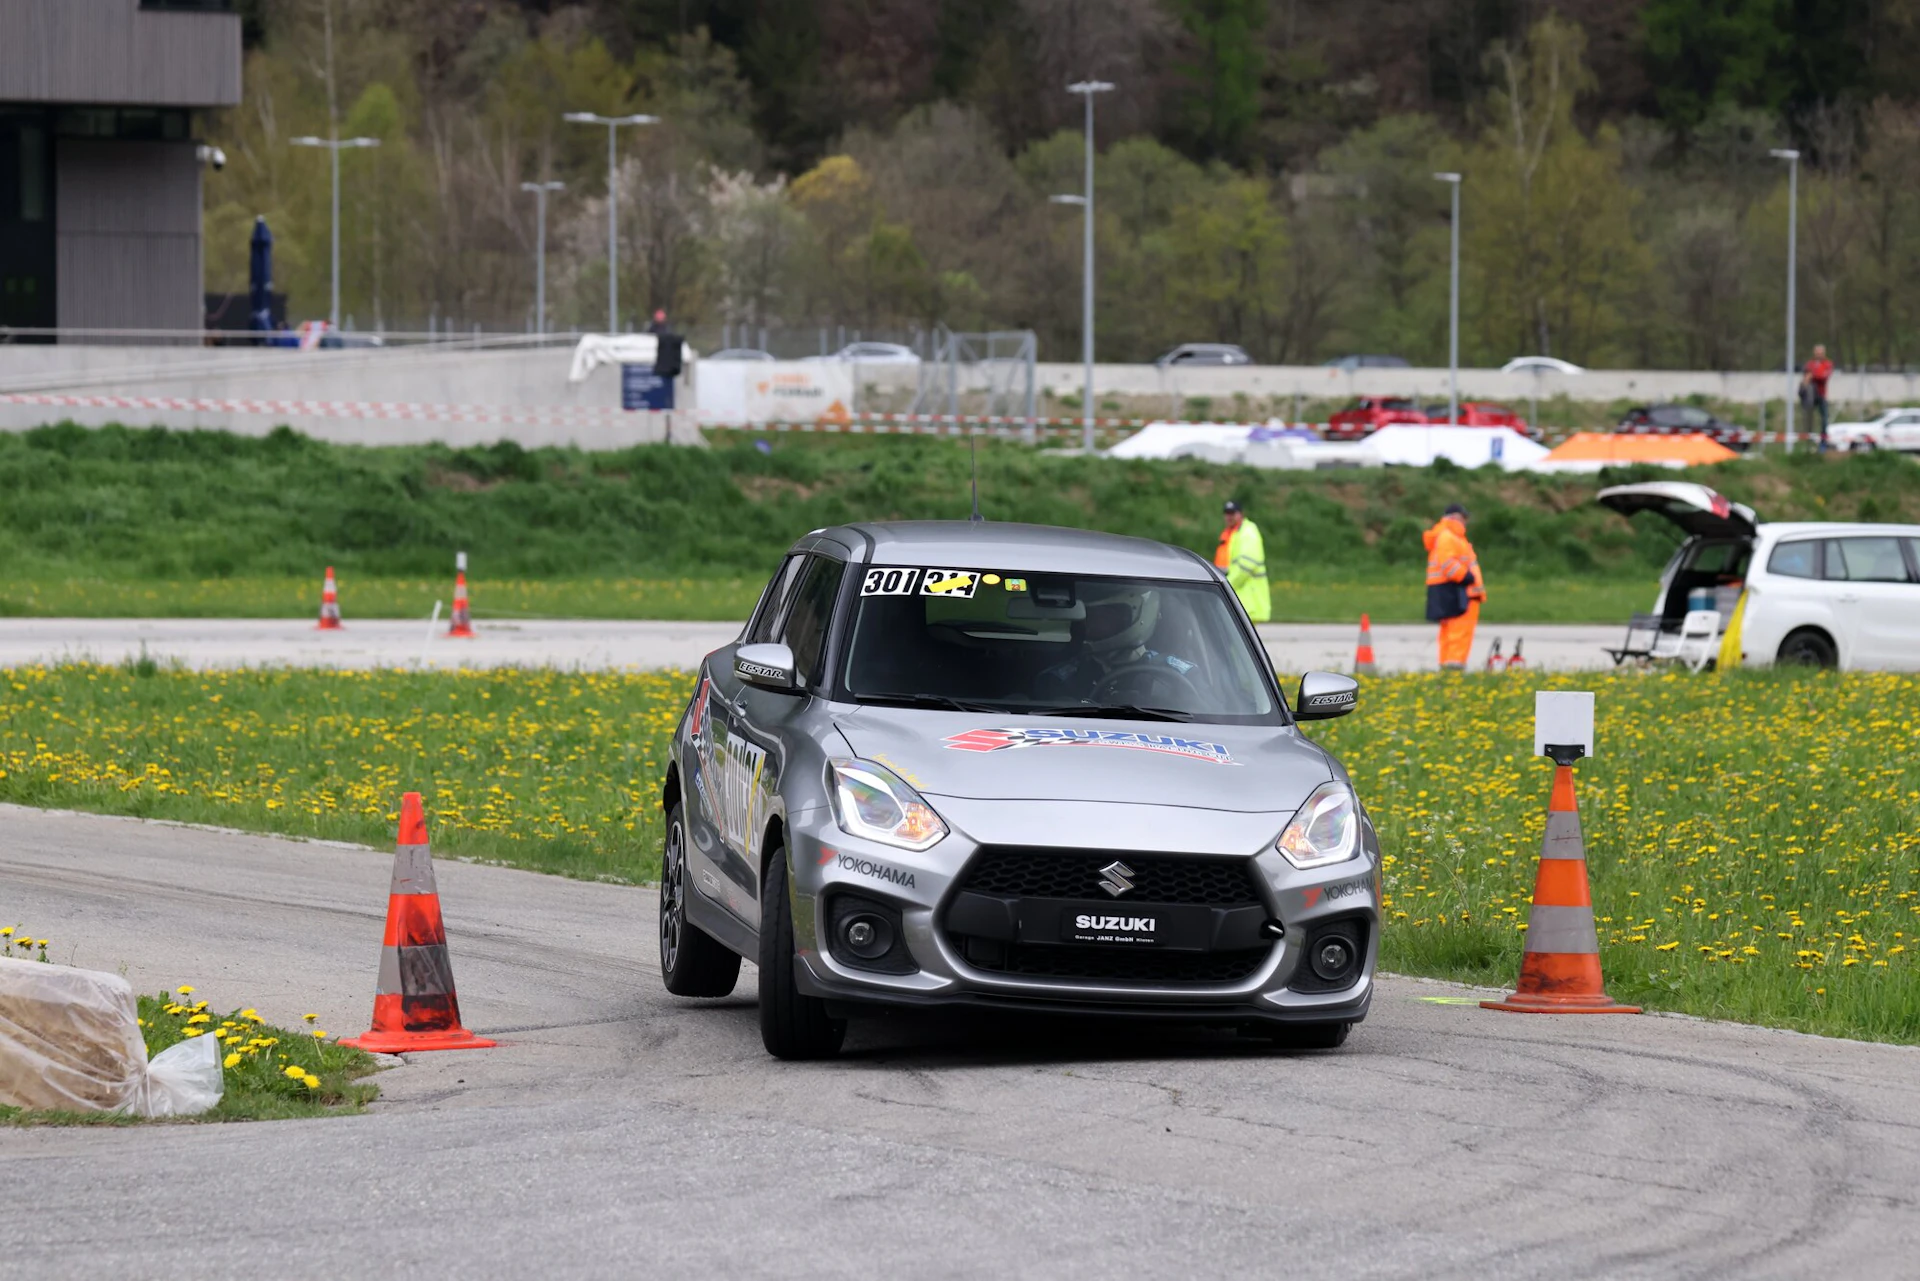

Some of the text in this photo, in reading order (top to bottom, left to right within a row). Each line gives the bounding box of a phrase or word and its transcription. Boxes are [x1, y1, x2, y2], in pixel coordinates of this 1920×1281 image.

[864, 570, 917, 593] 301
[1025, 728, 1230, 755] SUZUKI
[838, 853, 916, 889] YOKOHAMA
[1324, 876, 1375, 901] YOKOHAM
[1075, 914, 1156, 932] SUZUKI
